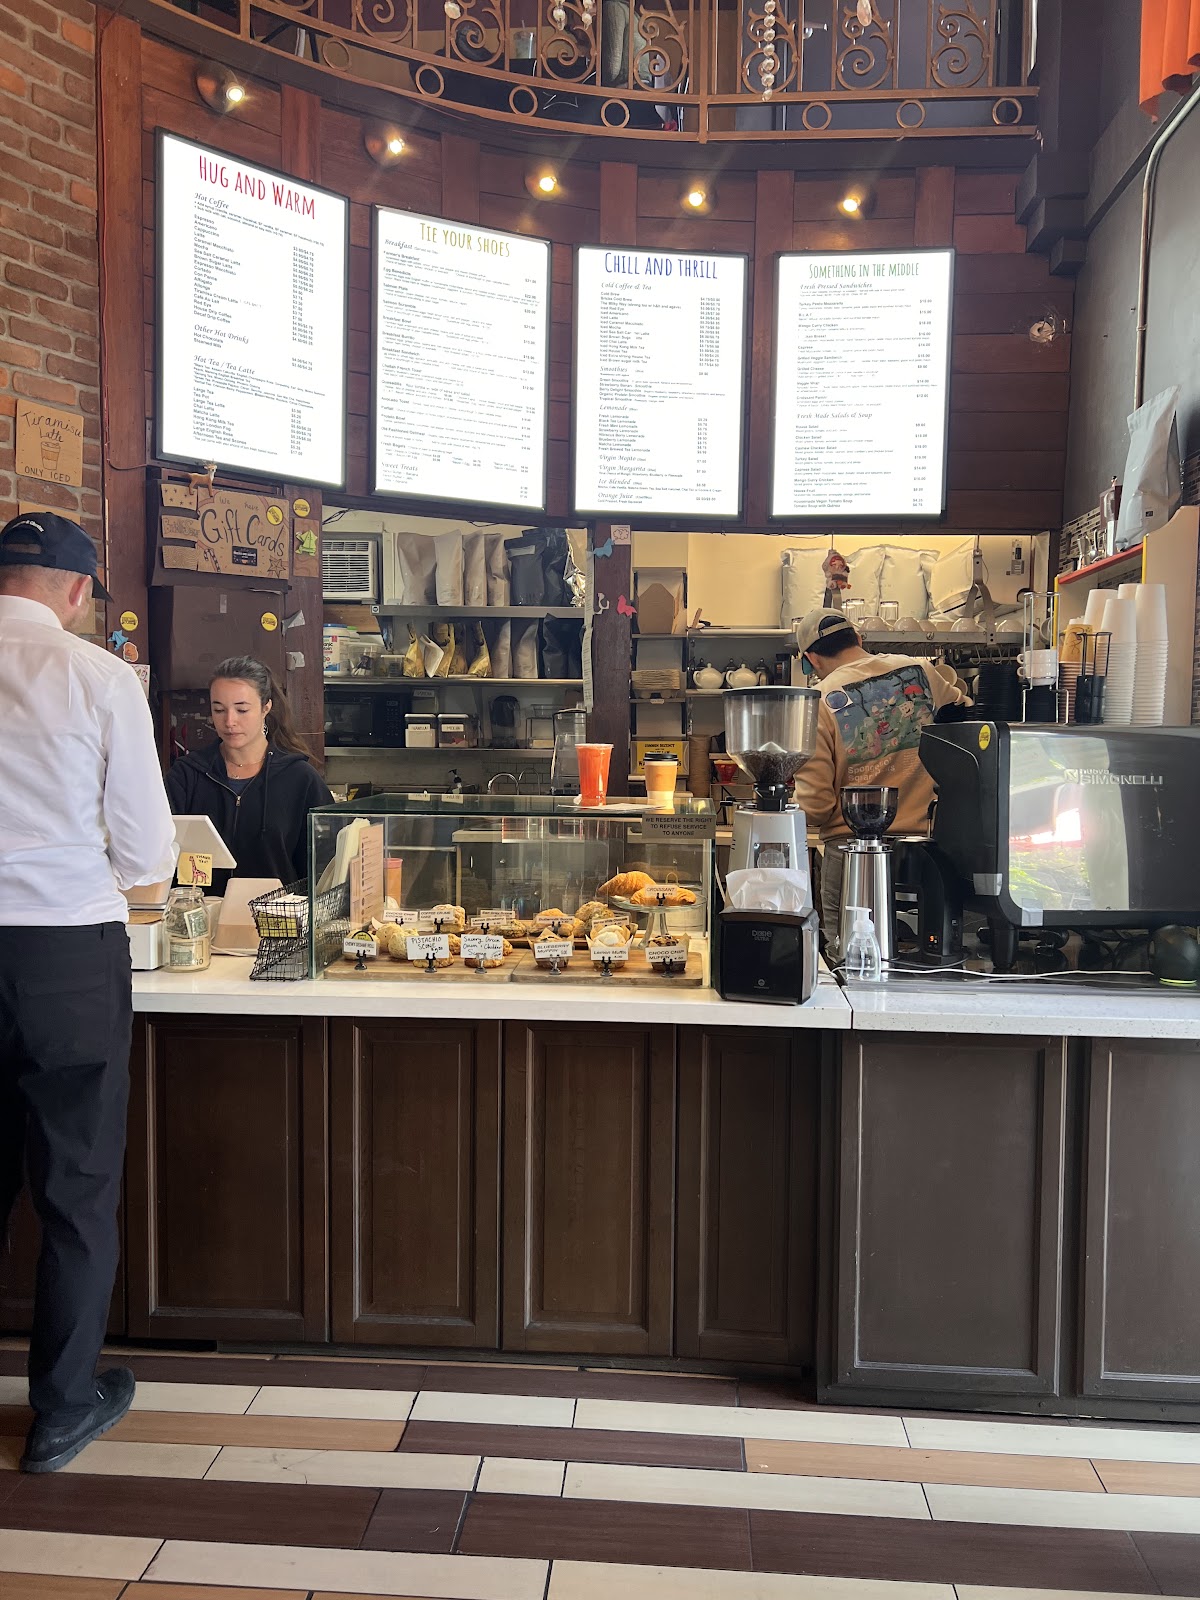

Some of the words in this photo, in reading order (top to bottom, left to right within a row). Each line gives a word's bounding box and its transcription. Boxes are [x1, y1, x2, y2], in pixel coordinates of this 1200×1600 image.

[200, 156, 228, 188] HUG
[235, 172, 266, 200] AND
[272, 182, 314, 219] WARM
[195, 192, 207, 202] Hot
[209, 196, 229, 211] Coffee
[420, 223, 438, 243] TIE
[443, 230, 472, 250] YOUR
[478, 237, 510, 257] SHOES
[605, 253, 640, 274] CHILL
[645, 257, 673, 276] AND
[678, 259, 718, 279] THRILL
[809, 264, 856, 278] SOMETHING
[859, 264, 869, 277] IN
[873, 263, 885, 276] THE
[888, 263, 919, 276] MIDDLE
[21, 411, 81, 437] Tiramisu
[39, 427, 64, 442] Latte
[25, 466, 43, 477] ONLY
[51, 472, 70, 482] ICED
[201, 509, 242, 545] Gift
[247, 514, 284, 556] Cards
[1080, 775, 1163, 784] SIMONELLI
